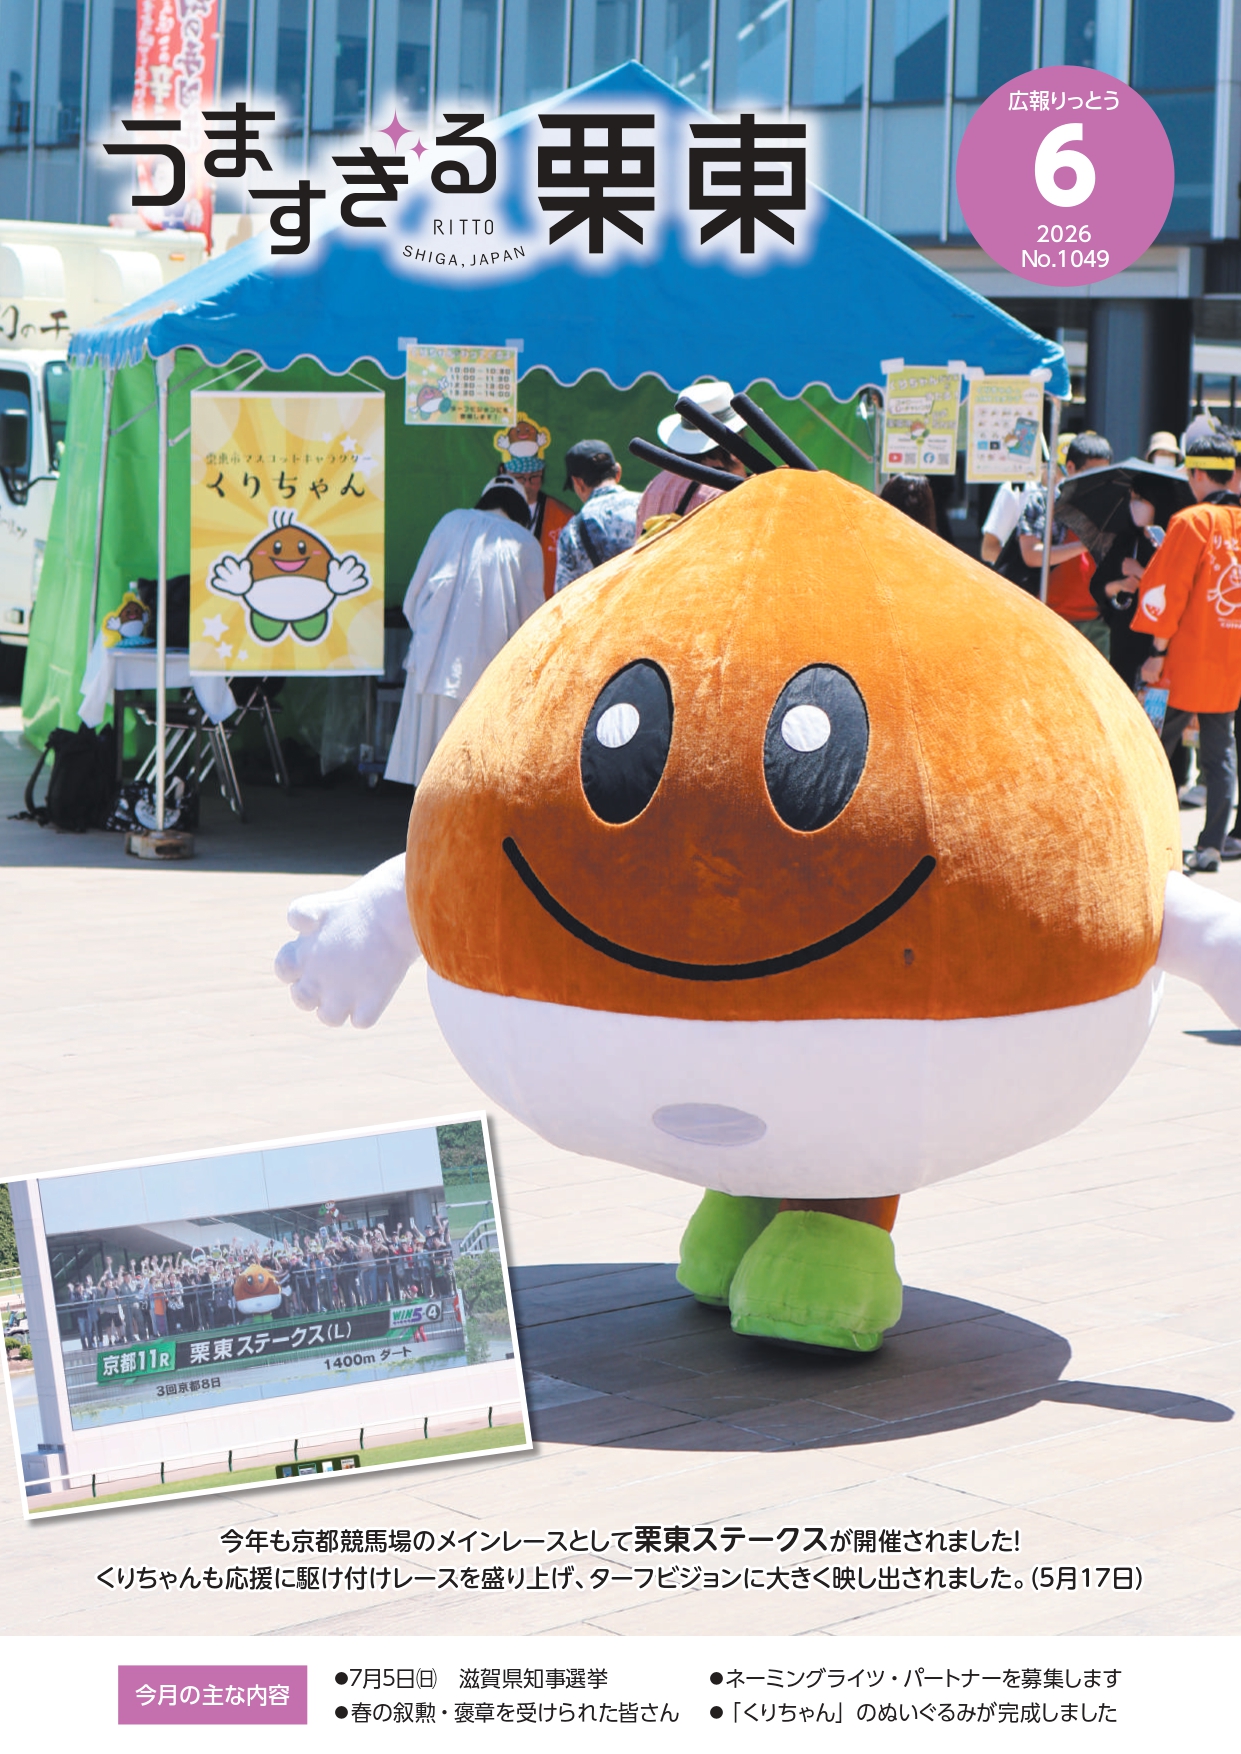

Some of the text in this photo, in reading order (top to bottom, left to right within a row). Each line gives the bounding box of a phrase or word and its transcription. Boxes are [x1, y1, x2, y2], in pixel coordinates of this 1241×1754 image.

[205, 451, 373, 466] 栗東市マスコットキャラクター
[206, 470, 366, 500] くりちゃん
[323, 1345, 412, 1371] 1400m ダート
[156, 1377, 222, 1398] 3回京都8日
